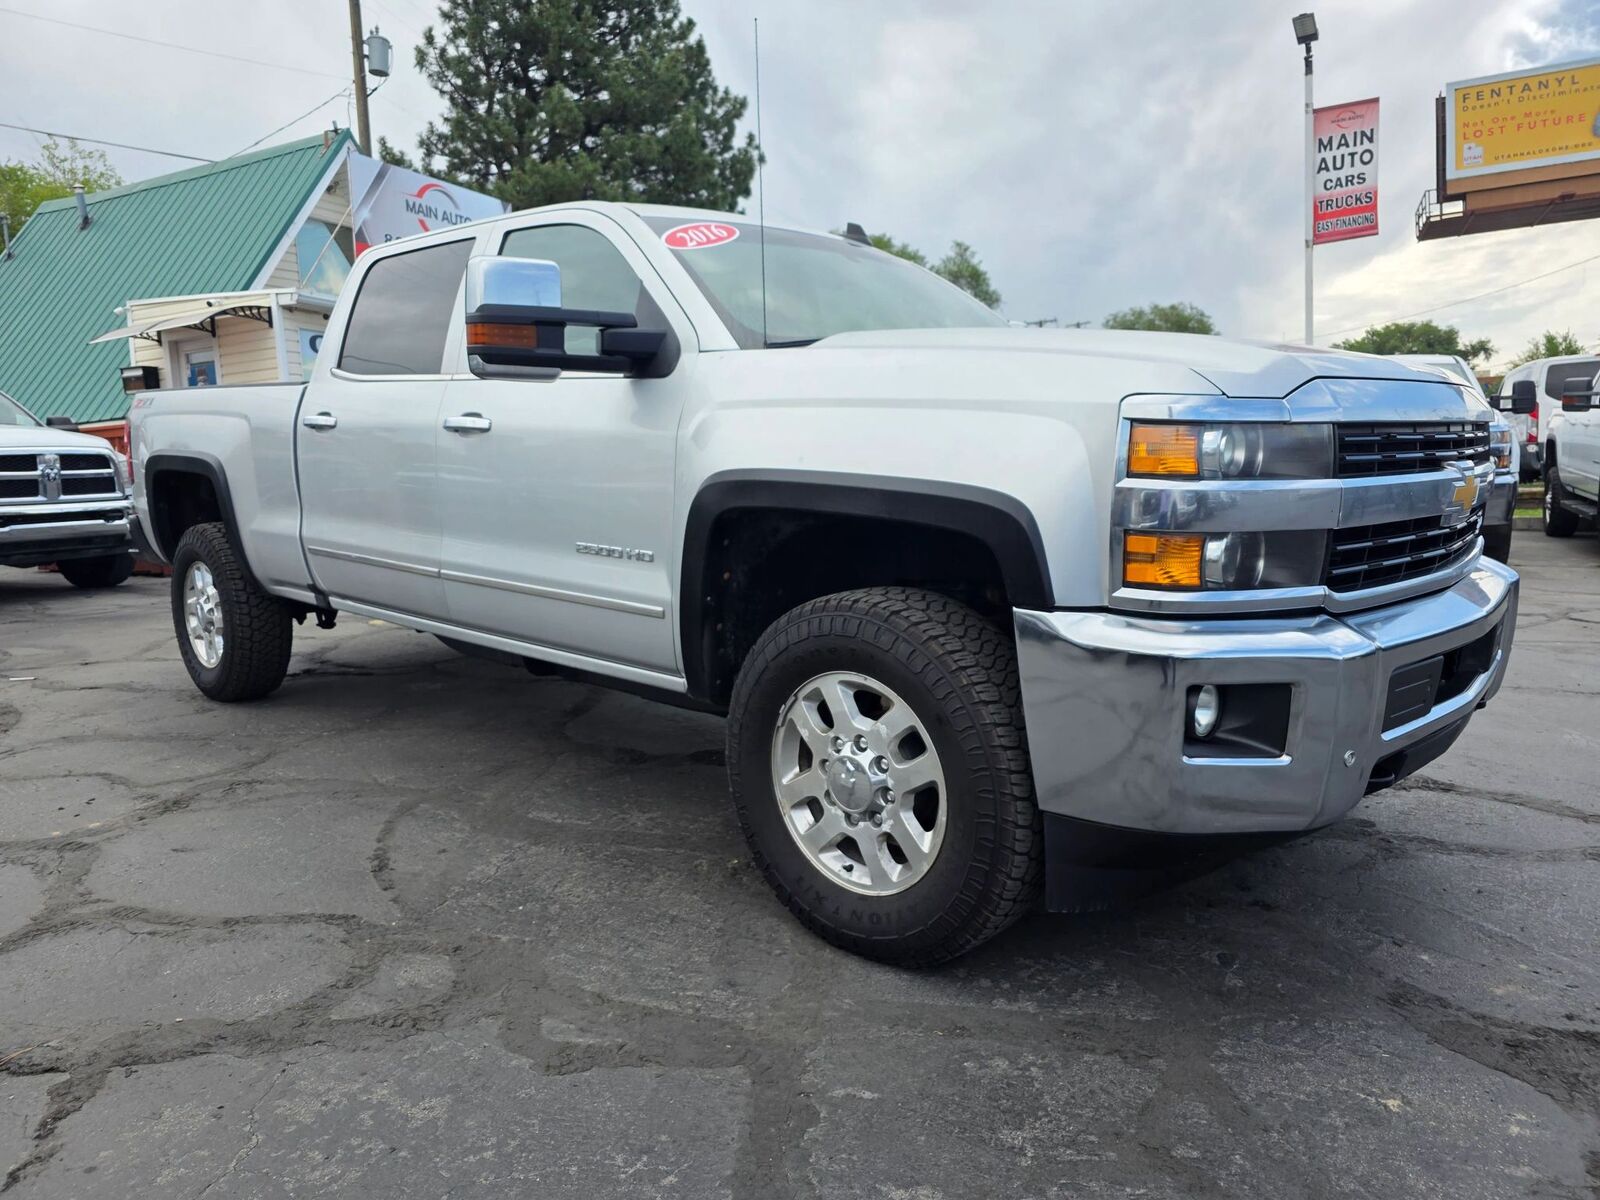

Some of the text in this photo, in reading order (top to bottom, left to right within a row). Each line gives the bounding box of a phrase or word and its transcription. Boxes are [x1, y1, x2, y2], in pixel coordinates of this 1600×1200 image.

[1462, 75, 1579, 103] FENTANYL
[1462, 98, 1511, 112] Doesn't
[1463, 109, 1557, 129] Not One More
[1463, 113, 1586, 140] LOST FUTURE
[1318, 128, 1374, 153] MAIN
[1317, 149, 1374, 174] AUTO
[1323, 172, 1366, 191] CARS
[405, 199, 438, 220] MAIN
[1318, 191, 1373, 212] TRUCKS
[1317, 213, 1375, 233] EASY FINANCING
[676, 224, 728, 247] 2016
